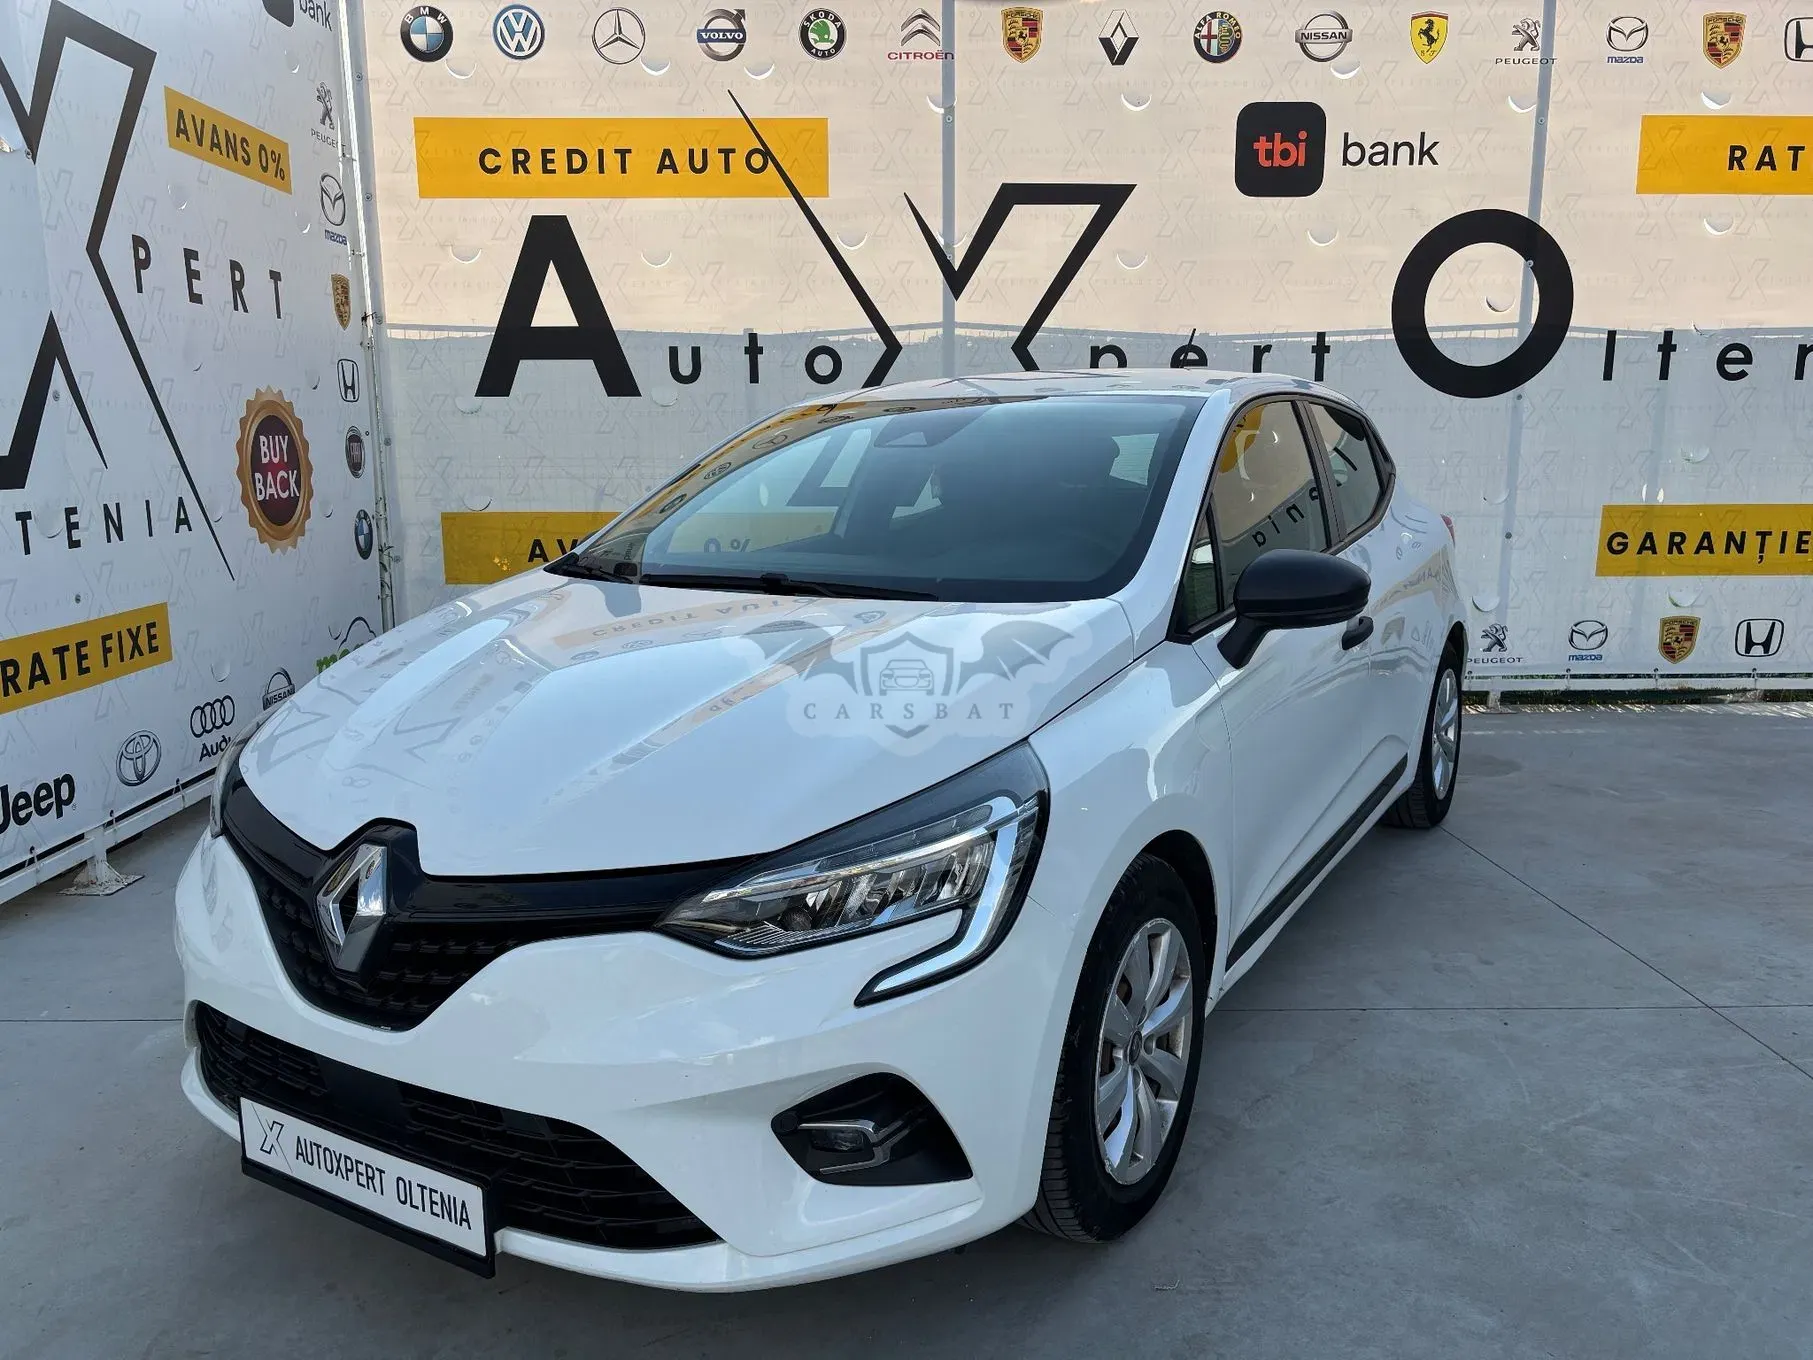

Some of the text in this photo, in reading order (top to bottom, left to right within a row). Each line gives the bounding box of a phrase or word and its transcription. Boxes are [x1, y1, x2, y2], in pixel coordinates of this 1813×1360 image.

[404, 7, 447, 24] BMW
[804, 11, 841, 29] SKODA
[1195, 12, 1241, 39] ALFA ROMEO
[700, 32, 743, 40] VOLVO
[1301, 32, 1347, 40] NISSAN
[811, 48, 835, 57] AUTO
[175, 109, 286, 181] AVANS 0%
[311, 128, 346, 157] PEUGET
[1254, 131, 1308, 167] tbi
[1342, 132, 1440, 166] bank
[479, 148, 769, 174] CREDIT AUTO
[1728, 145, 1806, 171] RAT
[260, 435, 288, 463] BUY
[254, 470, 300, 501] BACK
[1606, 531, 1813, 564] GARANȚIE
[0, 621, 159, 697] RATE FIXE
[0, 773, 75, 834] Jeep
[295, 1135, 386, 1196] AUTOXPERT
[396, 1176, 472, 1230] OLTENIA
